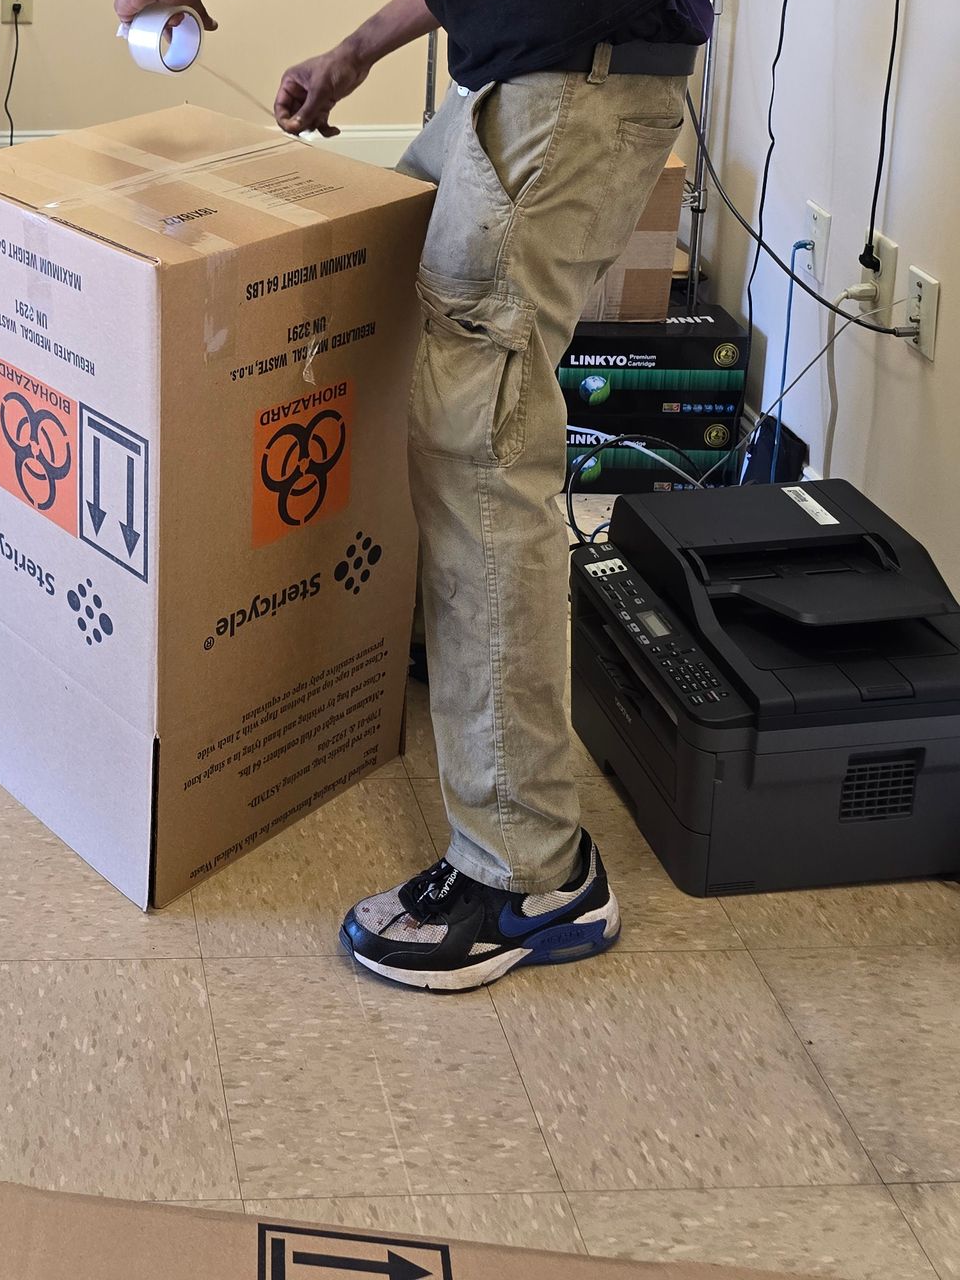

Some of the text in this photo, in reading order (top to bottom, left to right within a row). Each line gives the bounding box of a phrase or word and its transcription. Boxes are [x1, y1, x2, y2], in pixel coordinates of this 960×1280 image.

[8, 244, 38, 270] WEIGHT
[39, 257, 82, 291] MAXIMUM
[246, 247, 367, 301] MAXIMUM WEIGHT 64 LBS
[15, 299, 48, 330] UN 3291
[666, 315, 715, 324] LINK
[19, 324, 51, 353] MEDICAL
[287, 316, 327, 343] UN 3291
[331, 321, 376, 349] REGULATED
[53, 342, 95, 376] REGULATED
[255, 353, 288, 376] WASTE,
[570, 354, 628, 366] LINKYO
[627, 360, 656, 368] Cartridge
[259, 382, 348, 426] BIOHAZARD
[197, 744, 216, 760] wide
